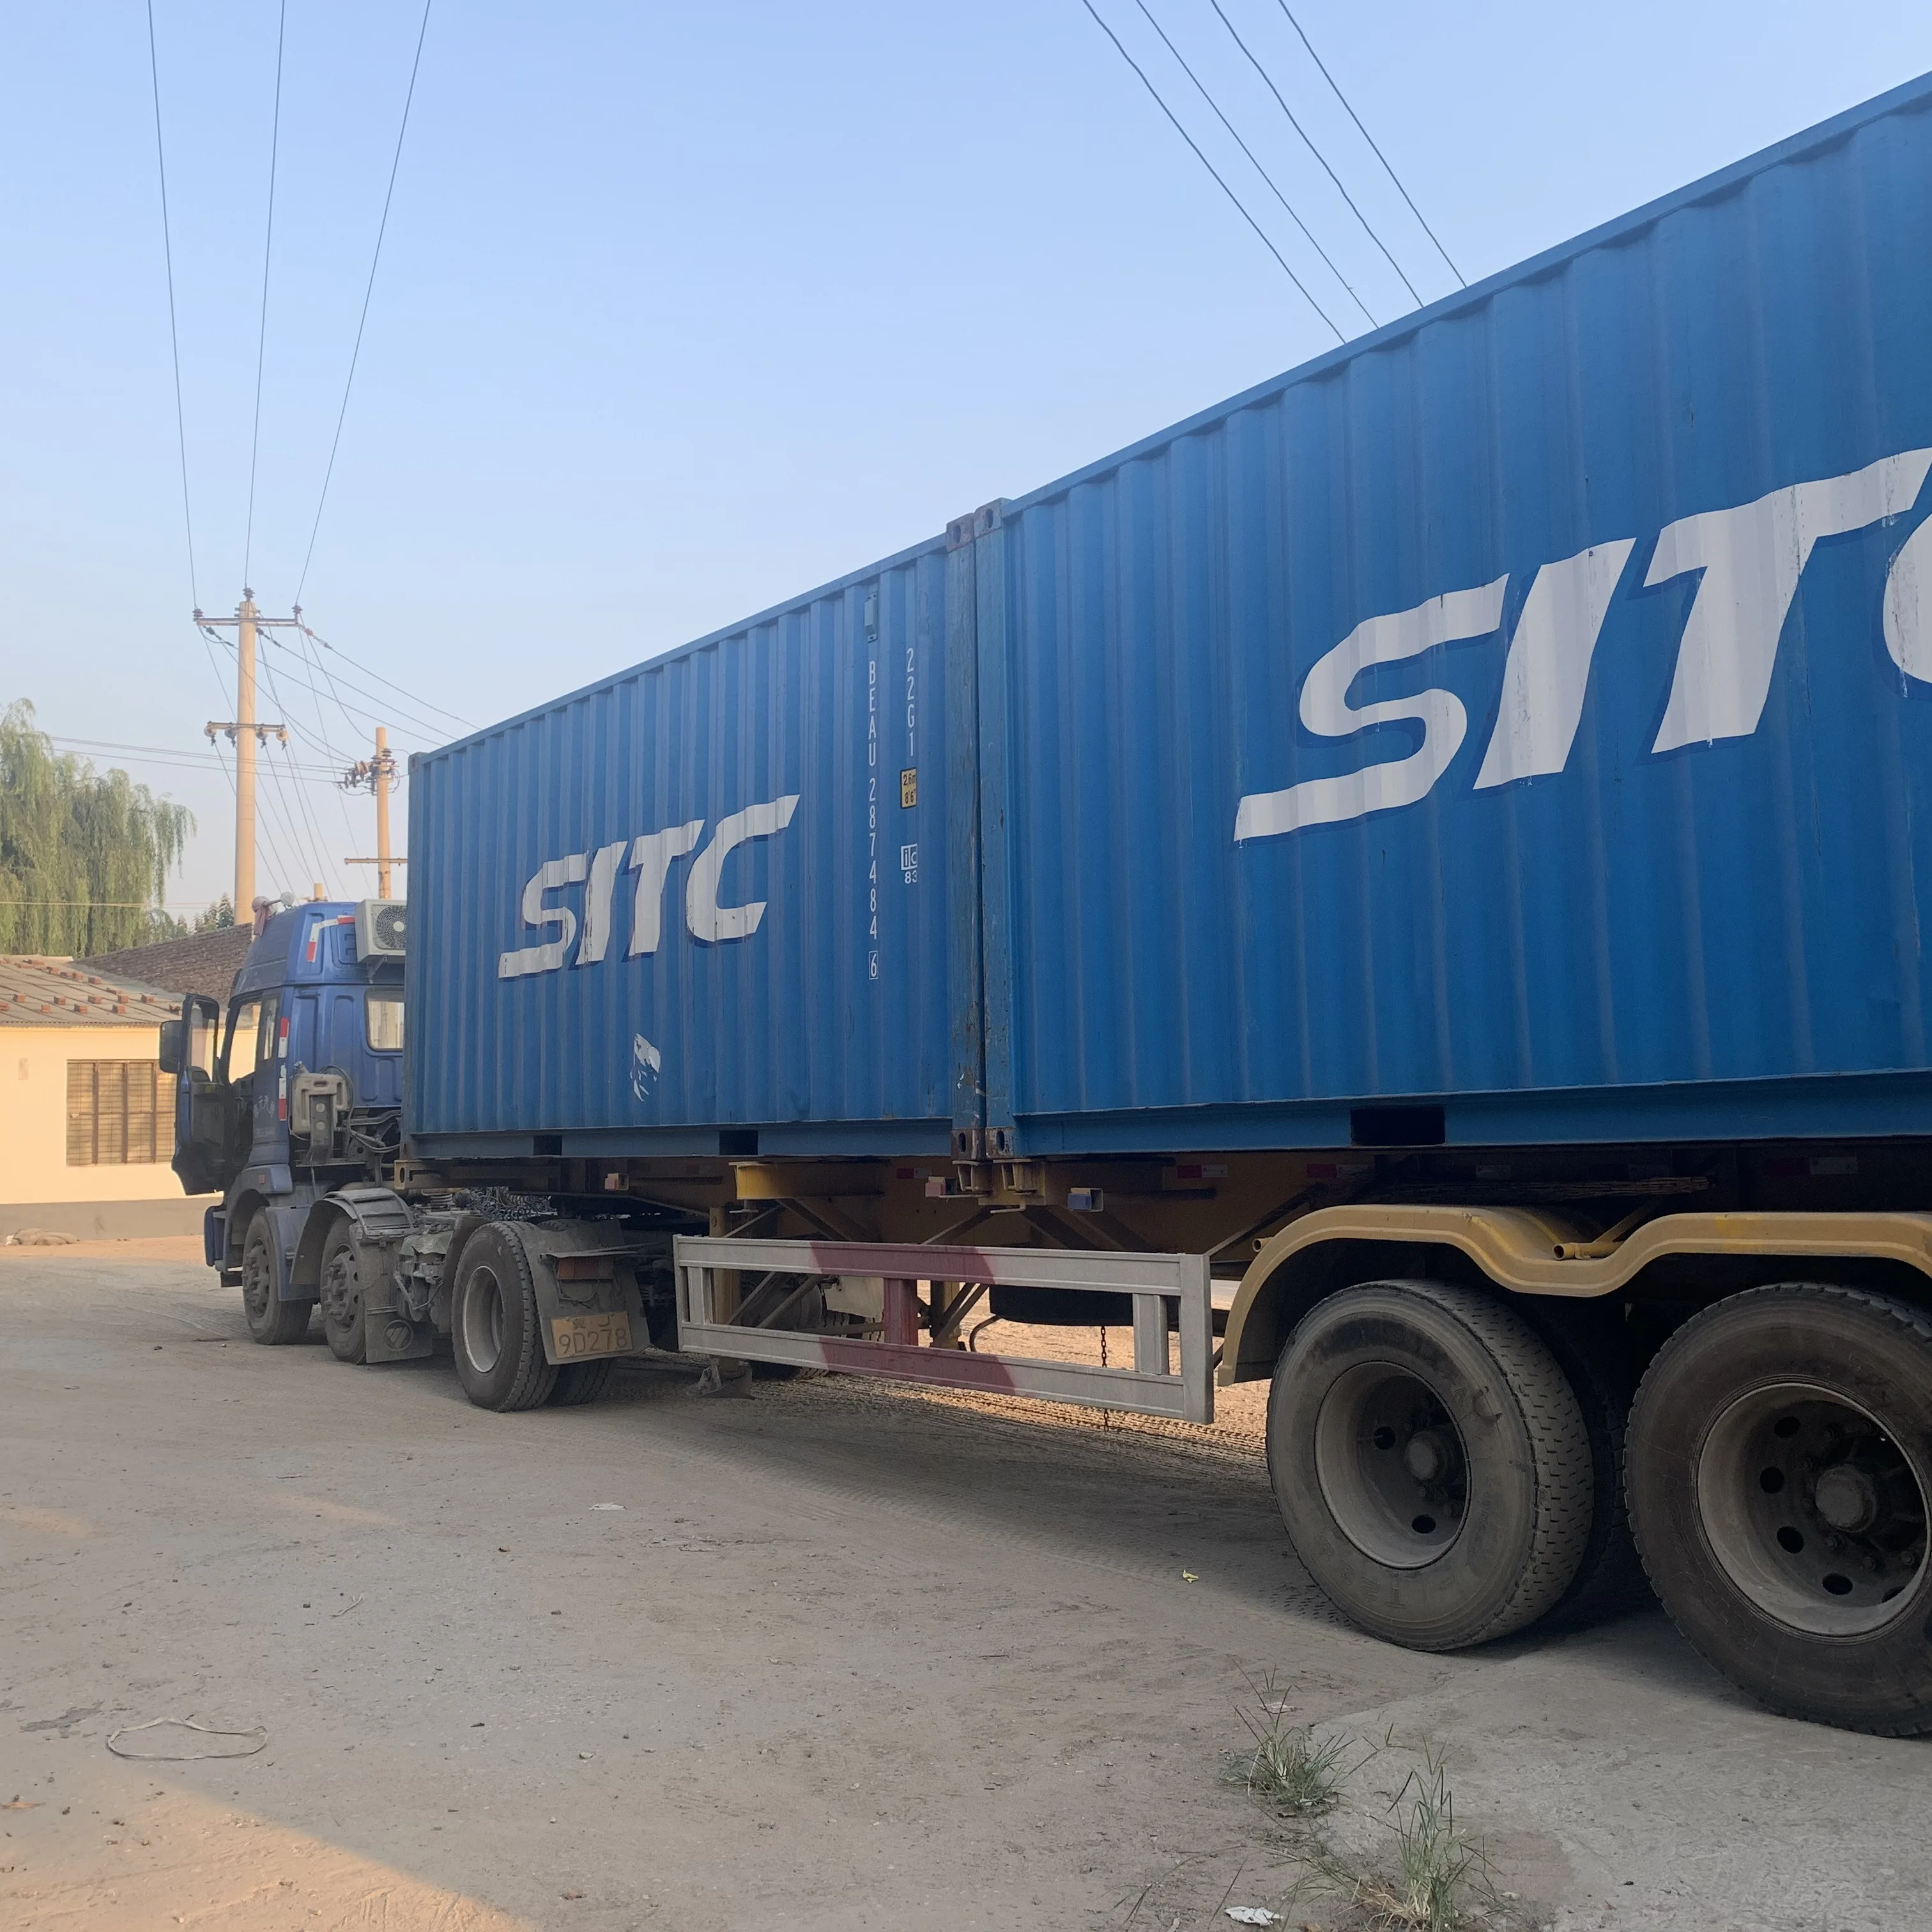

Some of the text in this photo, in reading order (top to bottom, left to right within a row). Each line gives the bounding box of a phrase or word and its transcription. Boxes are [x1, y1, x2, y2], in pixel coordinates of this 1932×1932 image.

[907, 647, 915, 756] 22G1
[1234, 447, 1932, 842] SIT
[498, 794, 800, 979] SITC
[868, 660, 878, 979] BEAU 287484 6
[558, 1328, 628, 1354] 9D278
